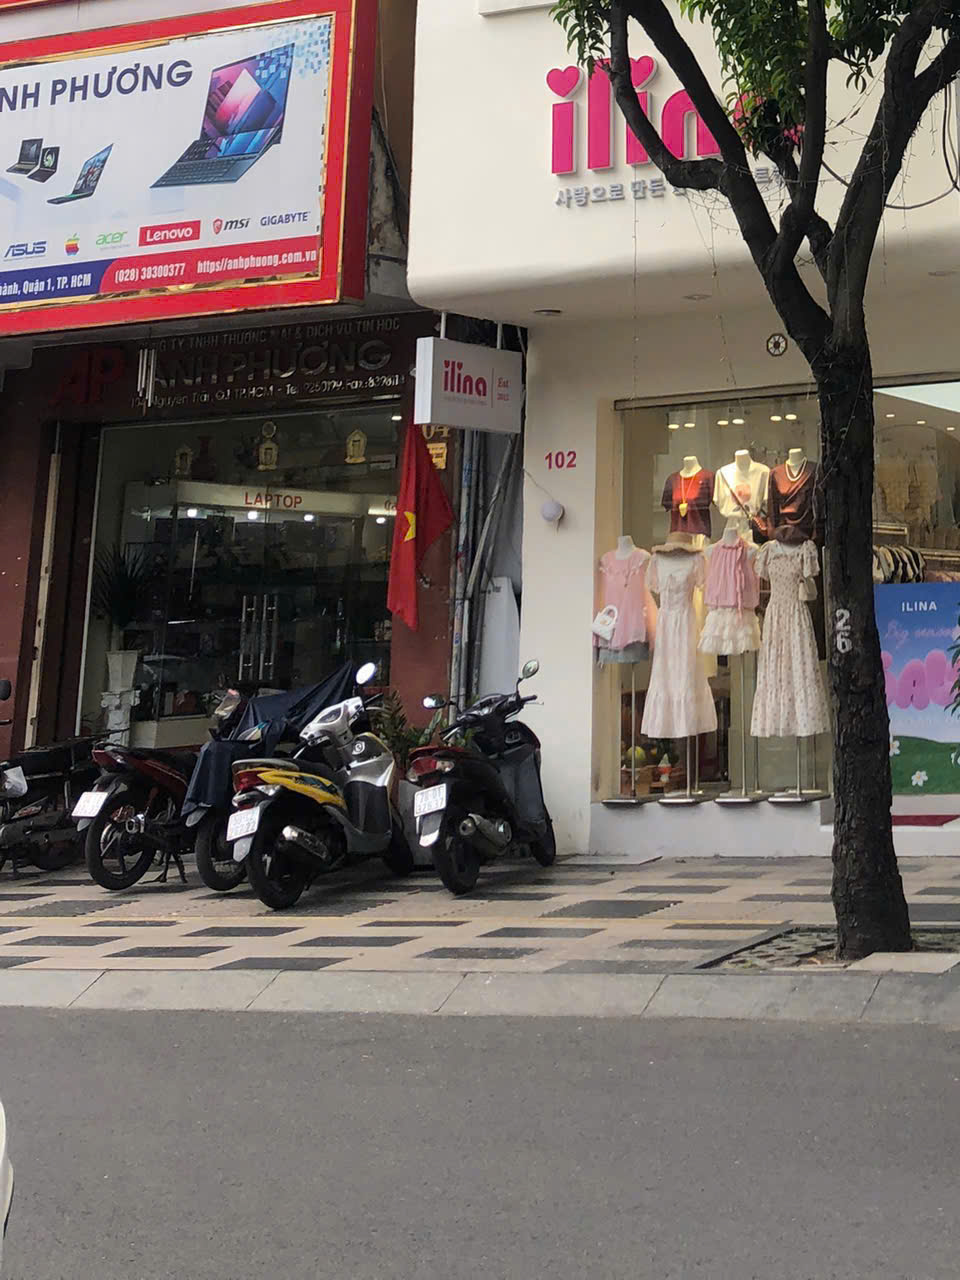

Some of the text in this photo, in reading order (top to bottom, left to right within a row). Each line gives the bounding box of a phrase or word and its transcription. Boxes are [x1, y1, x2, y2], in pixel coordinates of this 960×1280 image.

[50, 59, 193, 106] PHƯƠNG
[546, 55, 806, 175] ilin
[555, 183, 624, 208] 사랑으로
[223, 217, 251, 231] msi
[260, 211, 309, 227] GIGABYTE
[96, 230, 128, 245] acer
[146, 226, 193, 242] Lenovo
[4, 241, 47, 258] ASUS
[22, 279, 45, 295] Quận
[56, 275, 69, 289] TP.
[70, 273, 92, 287] HCM
[114, 267, 139, 284] (028)
[443, 359, 487, 397] ilina
[544, 450, 577, 470] 102
[244, 491, 303, 509] LAPTOP
[901, 601, 937, 612] ILINA
